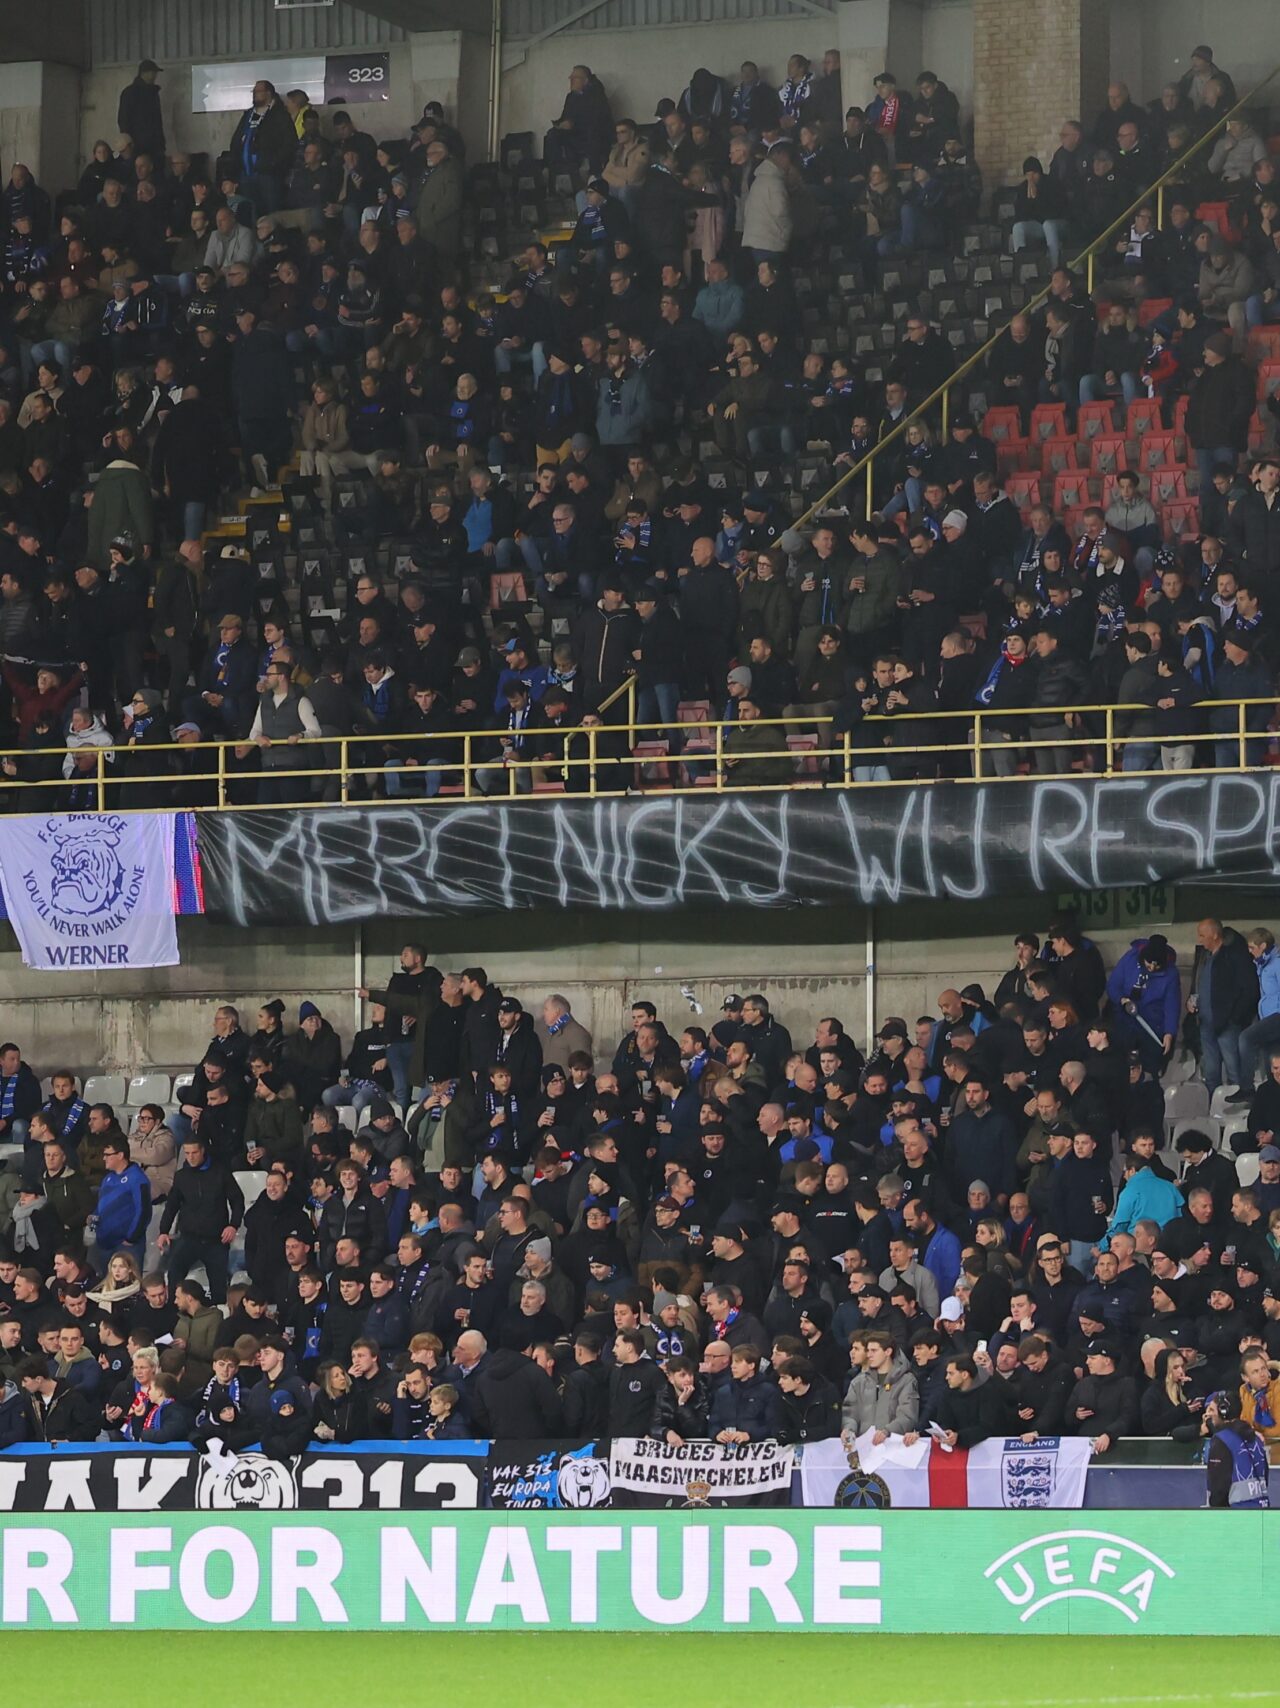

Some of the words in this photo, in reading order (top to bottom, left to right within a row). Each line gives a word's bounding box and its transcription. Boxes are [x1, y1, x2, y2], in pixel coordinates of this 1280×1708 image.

[348, 67, 384, 83] 323
[67, 813, 128, 836] BRUGGE
[224, 803, 514, 928] MERCI
[553, 794, 791, 908] NICKY
[838, 788, 987, 902] WIJ
[23, 869, 50, 921] YOU'LL
[50, 915, 90, 938] NEVER
[91, 912, 127, 937] WALK
[123, 864, 146, 915] ALONE
[1125, 885, 1168, 915] 314
[45, 944, 130, 966] WERNER
[1008, 1439, 1056, 1449] ENGLAND
[492, 1464, 522, 1480] VAK
[523, 1462, 552, 1476] 313
[614, 1459, 788, 1488] MAASMECHELEN
[491, 1481, 551, 1498] EUROPA
[109, 1525, 350, 1624] FOR
[379, 1525, 883, 1625] NATURE
[994, 1543, 1156, 1612] UEFA
